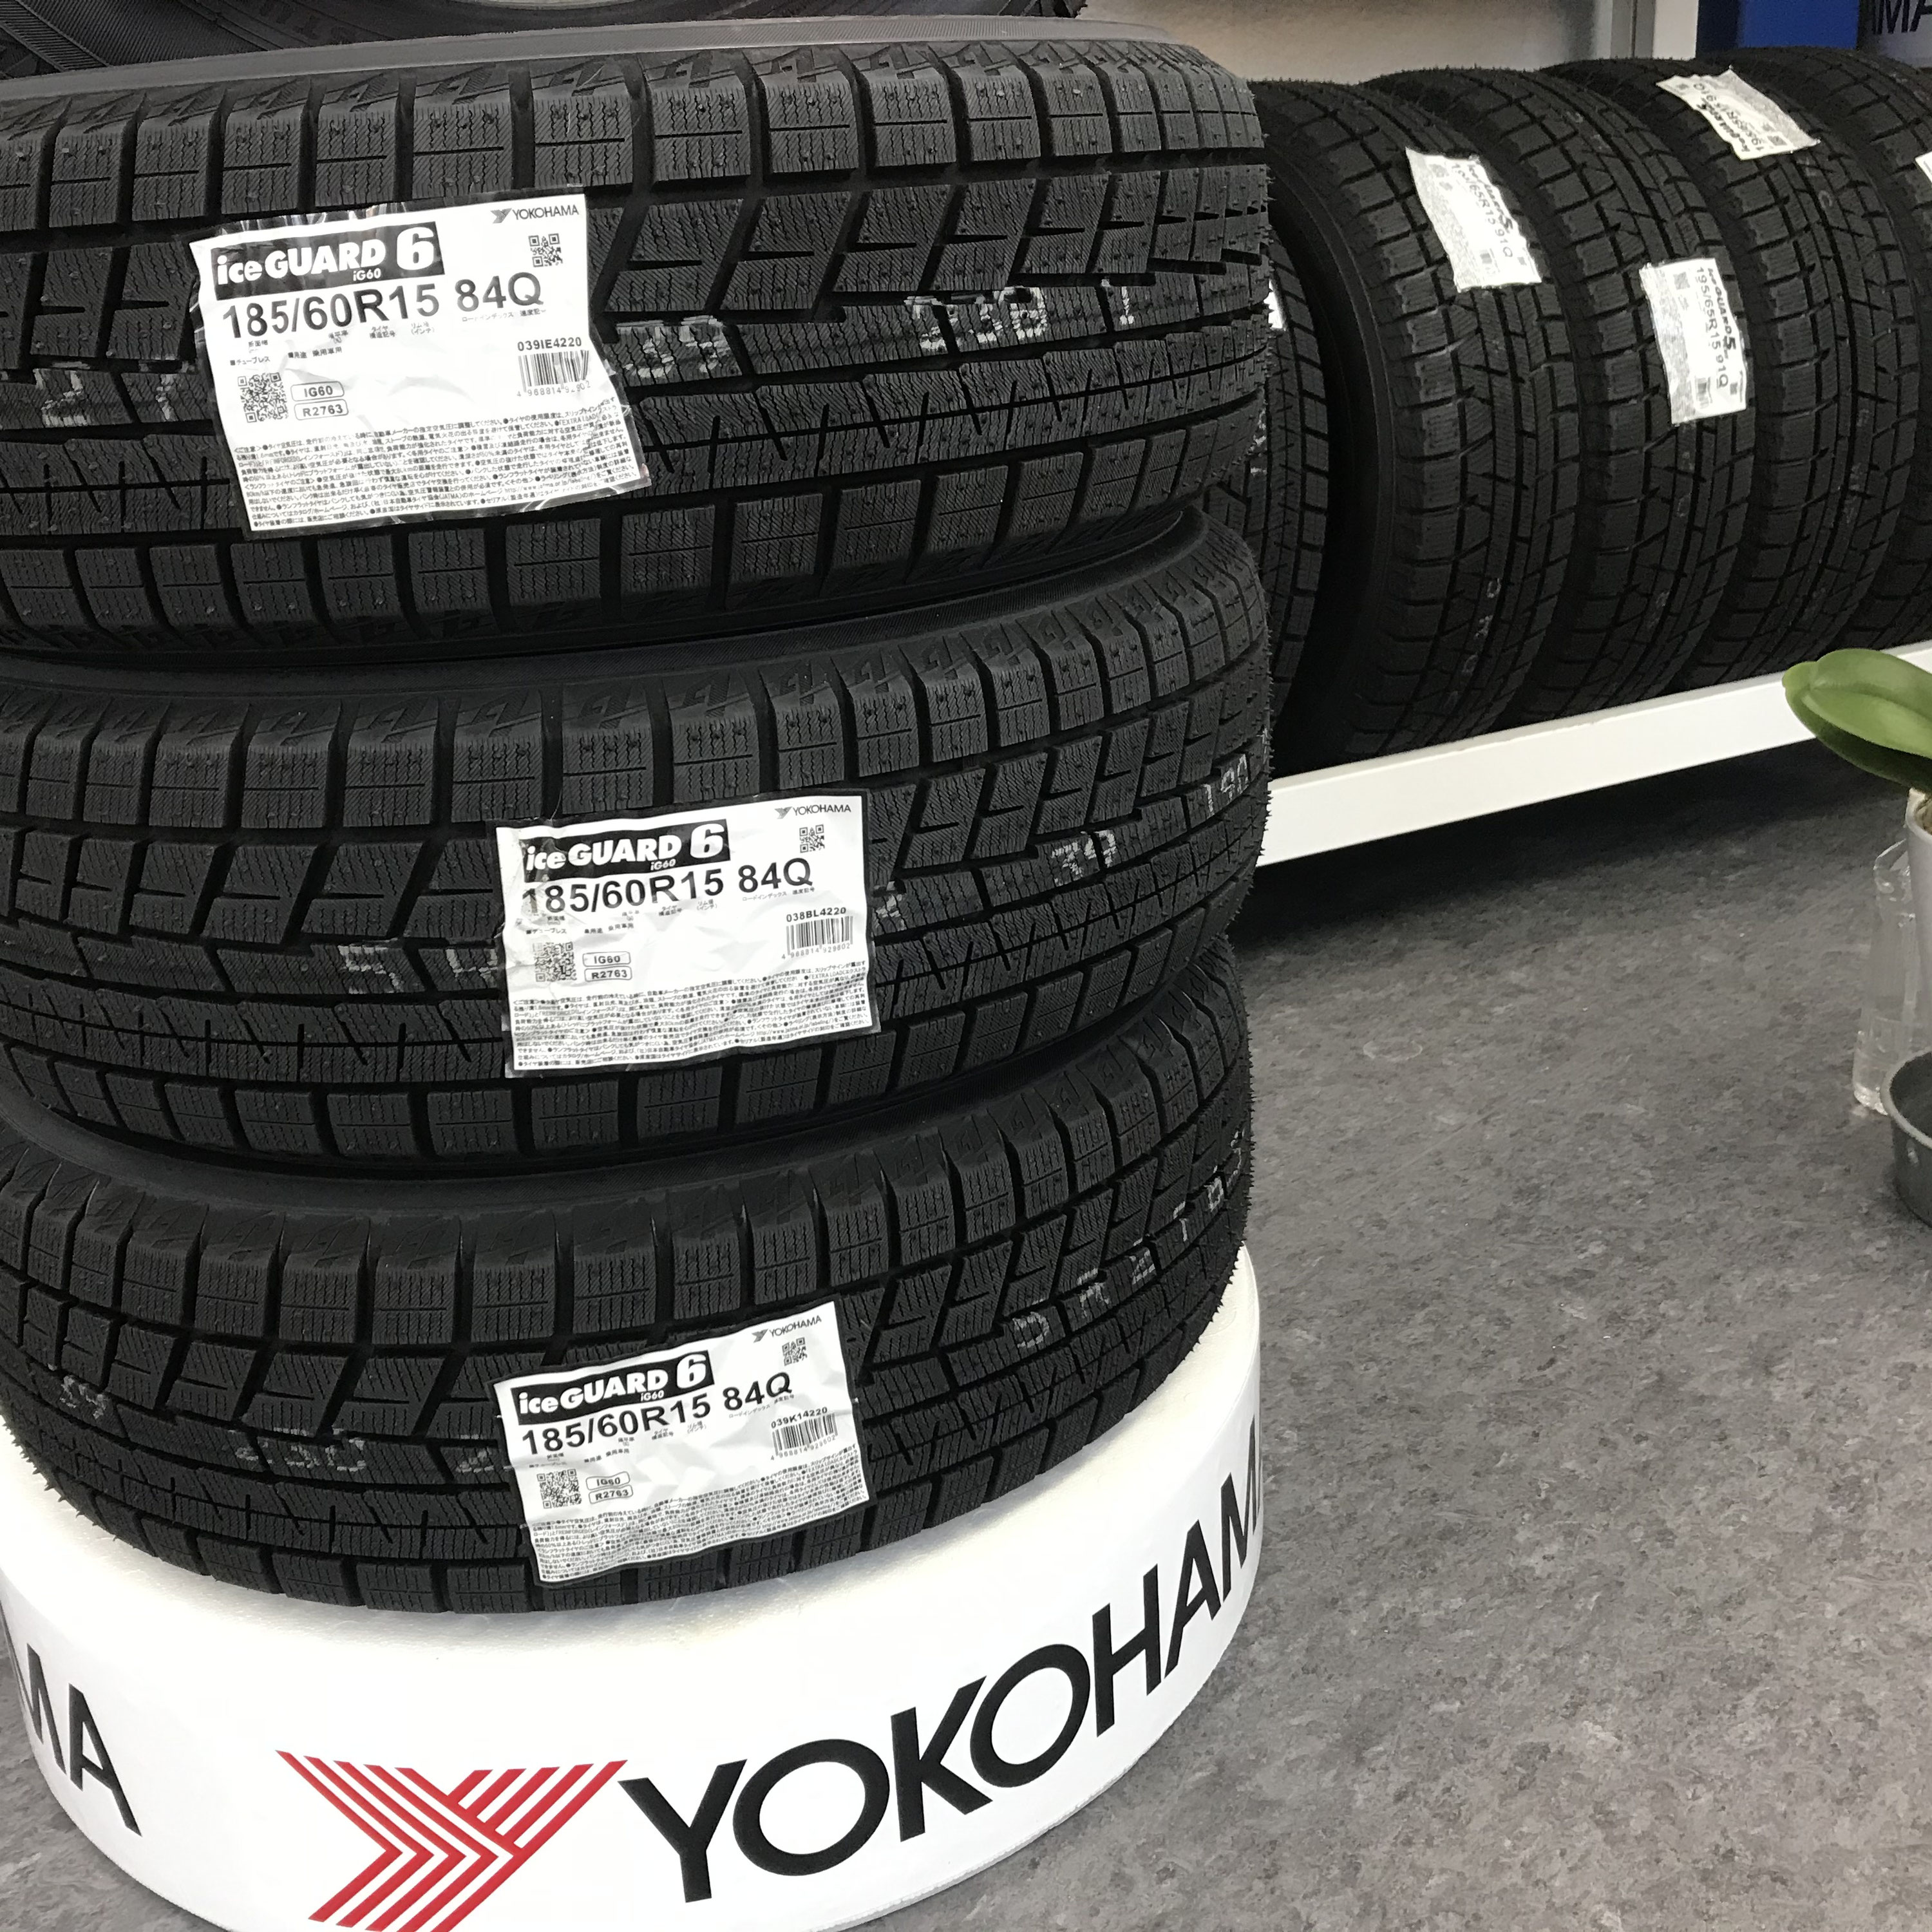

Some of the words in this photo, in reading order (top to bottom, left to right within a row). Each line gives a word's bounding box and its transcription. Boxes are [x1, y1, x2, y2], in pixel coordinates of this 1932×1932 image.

[512, 205, 579, 220] YOKOHAMA
[217, 238, 386, 285] iceGUARD
[397, 227, 434, 270] 6
[354, 268, 381, 281] iG60
[223, 283, 439, 338] 185/60R15
[455, 272, 544, 312] 84Q
[304, 385, 334, 398] IG60
[302, 404, 344, 417] R2763
[793, 804, 851, 816] YOKOHAMA
[526, 835, 681, 870] iceGUARD
[690, 823, 724, 858] 6
[650, 858, 676, 871] iG60
[522, 868, 724, 913] 185/60R15
[738, 858, 813, 893] 84Q
[786, 907, 847, 922] 038BL4220
[591, 970, 627, 980] R2763
[769, 1315, 822, 1338] YOKOHAMA
[518, 1369, 668, 1415] iceGUARD
[676, 1354, 706, 1389] 6
[640, 1390, 665, 1402] iG60
[522, 1392, 711, 1455] 185/60R15
[723, 1372, 792, 1410] 84Q
[595, 1489, 629, 1501] R2763
[618, 1412, 1261, 1904] YOKOHAM
